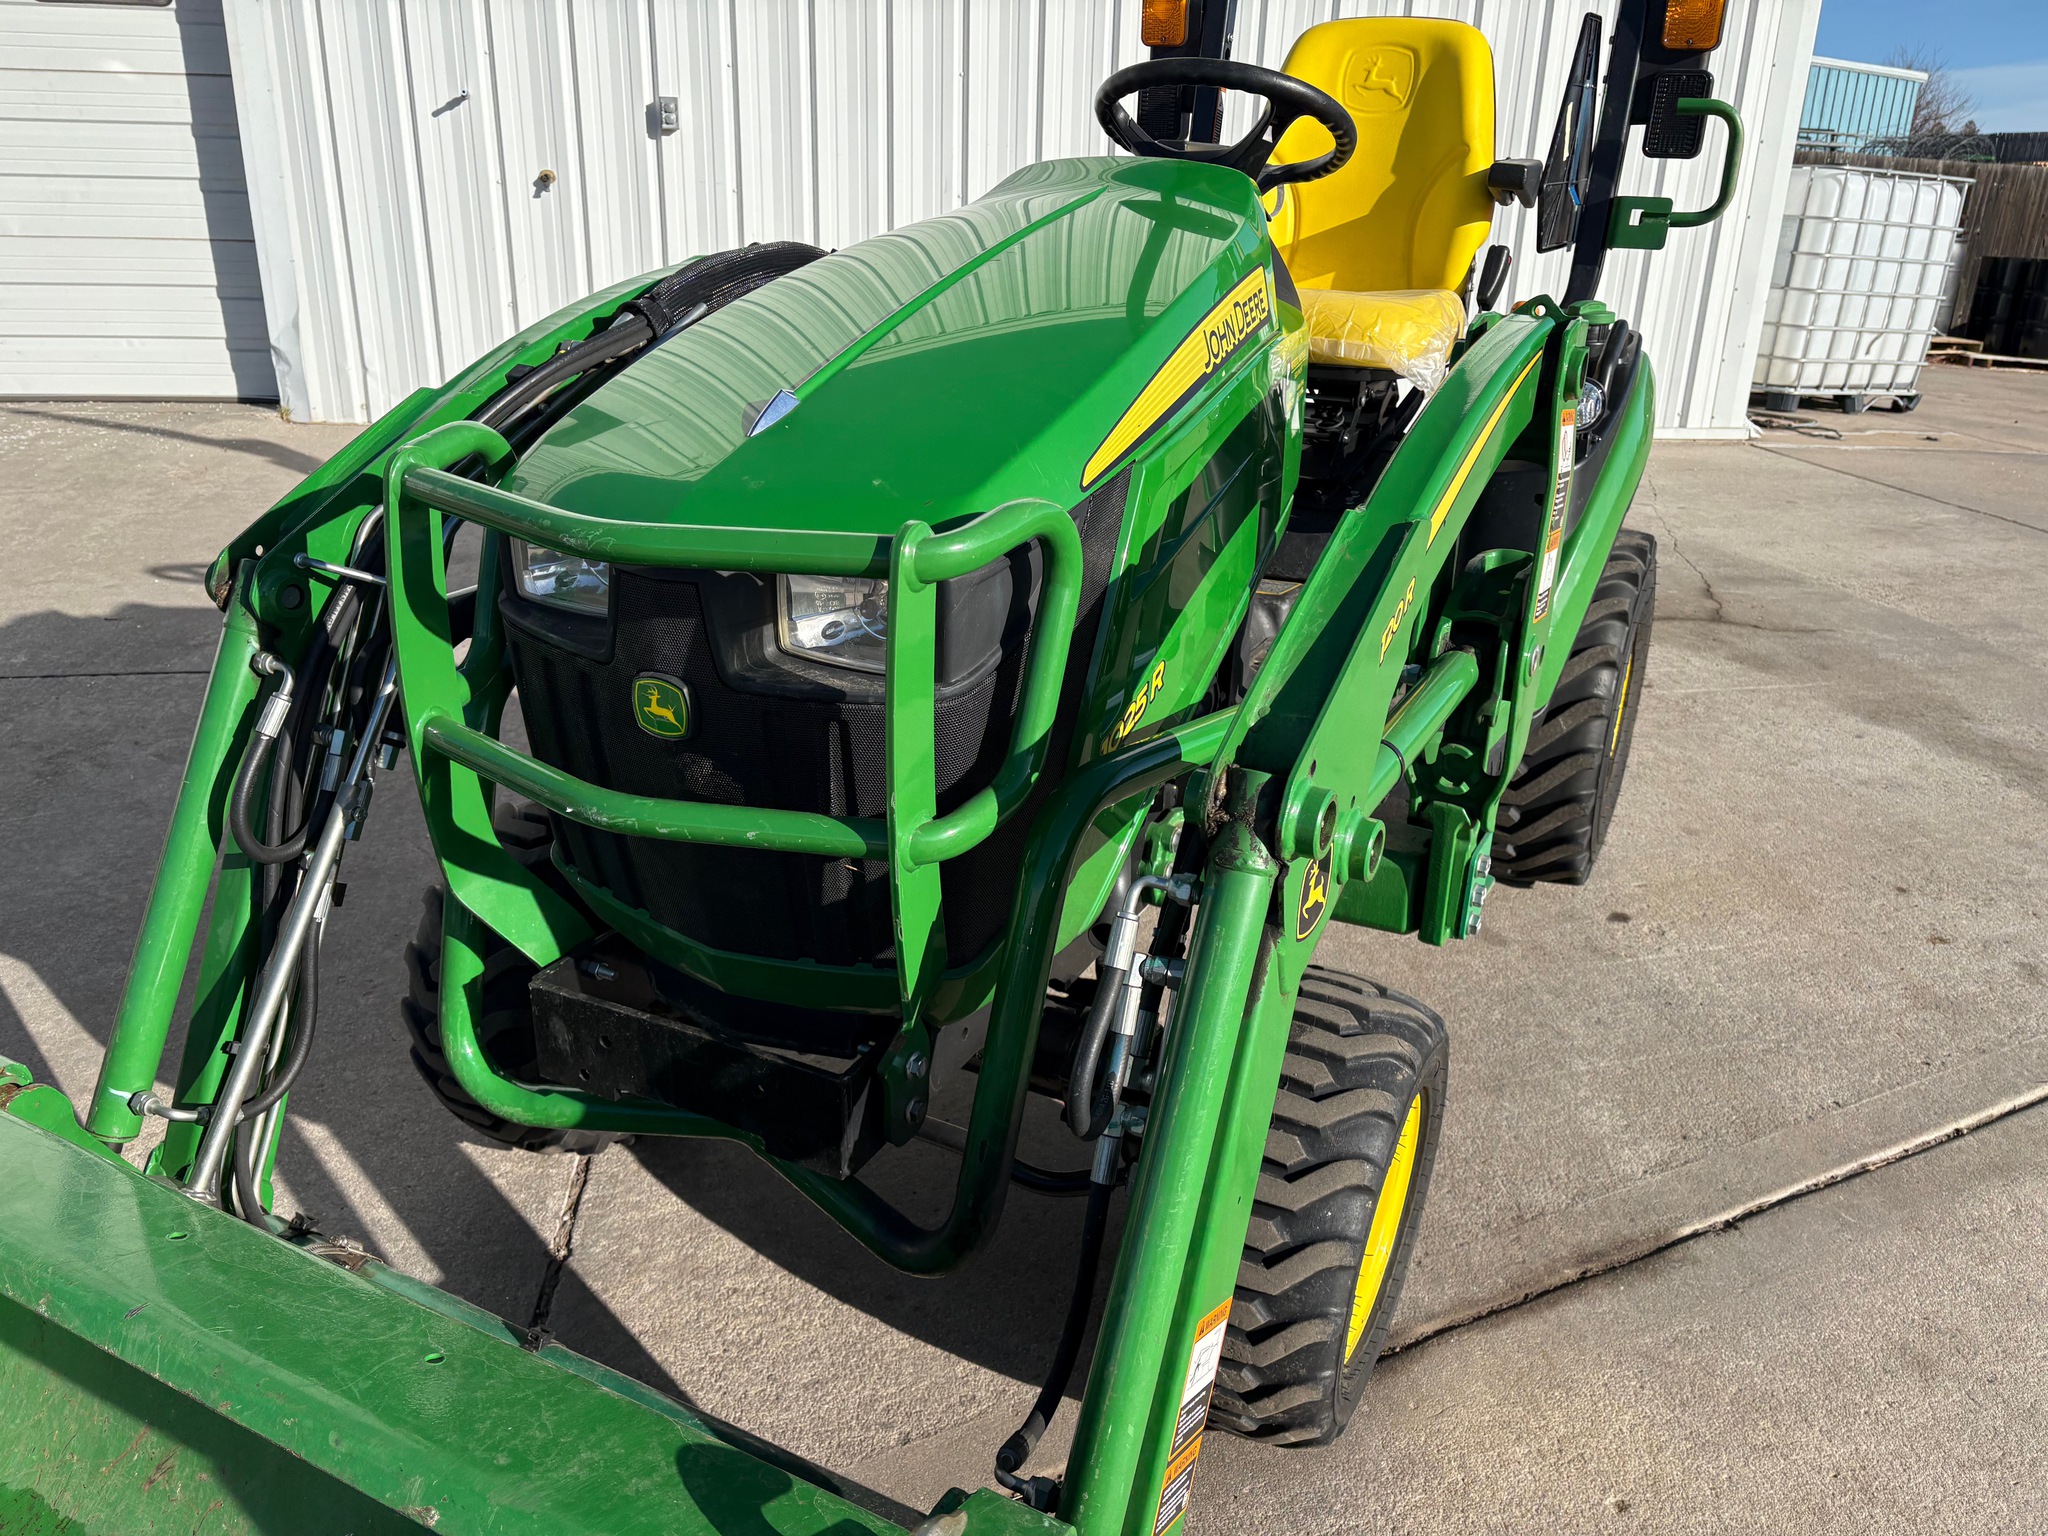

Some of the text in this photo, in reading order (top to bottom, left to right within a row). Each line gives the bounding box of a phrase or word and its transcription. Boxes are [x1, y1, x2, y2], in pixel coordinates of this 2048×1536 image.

[1203, 288, 1266, 369] JOHN DEERE
[1204, 1305, 1229, 1333] WARNING
[1173, 1446, 1198, 1477] WARNING
